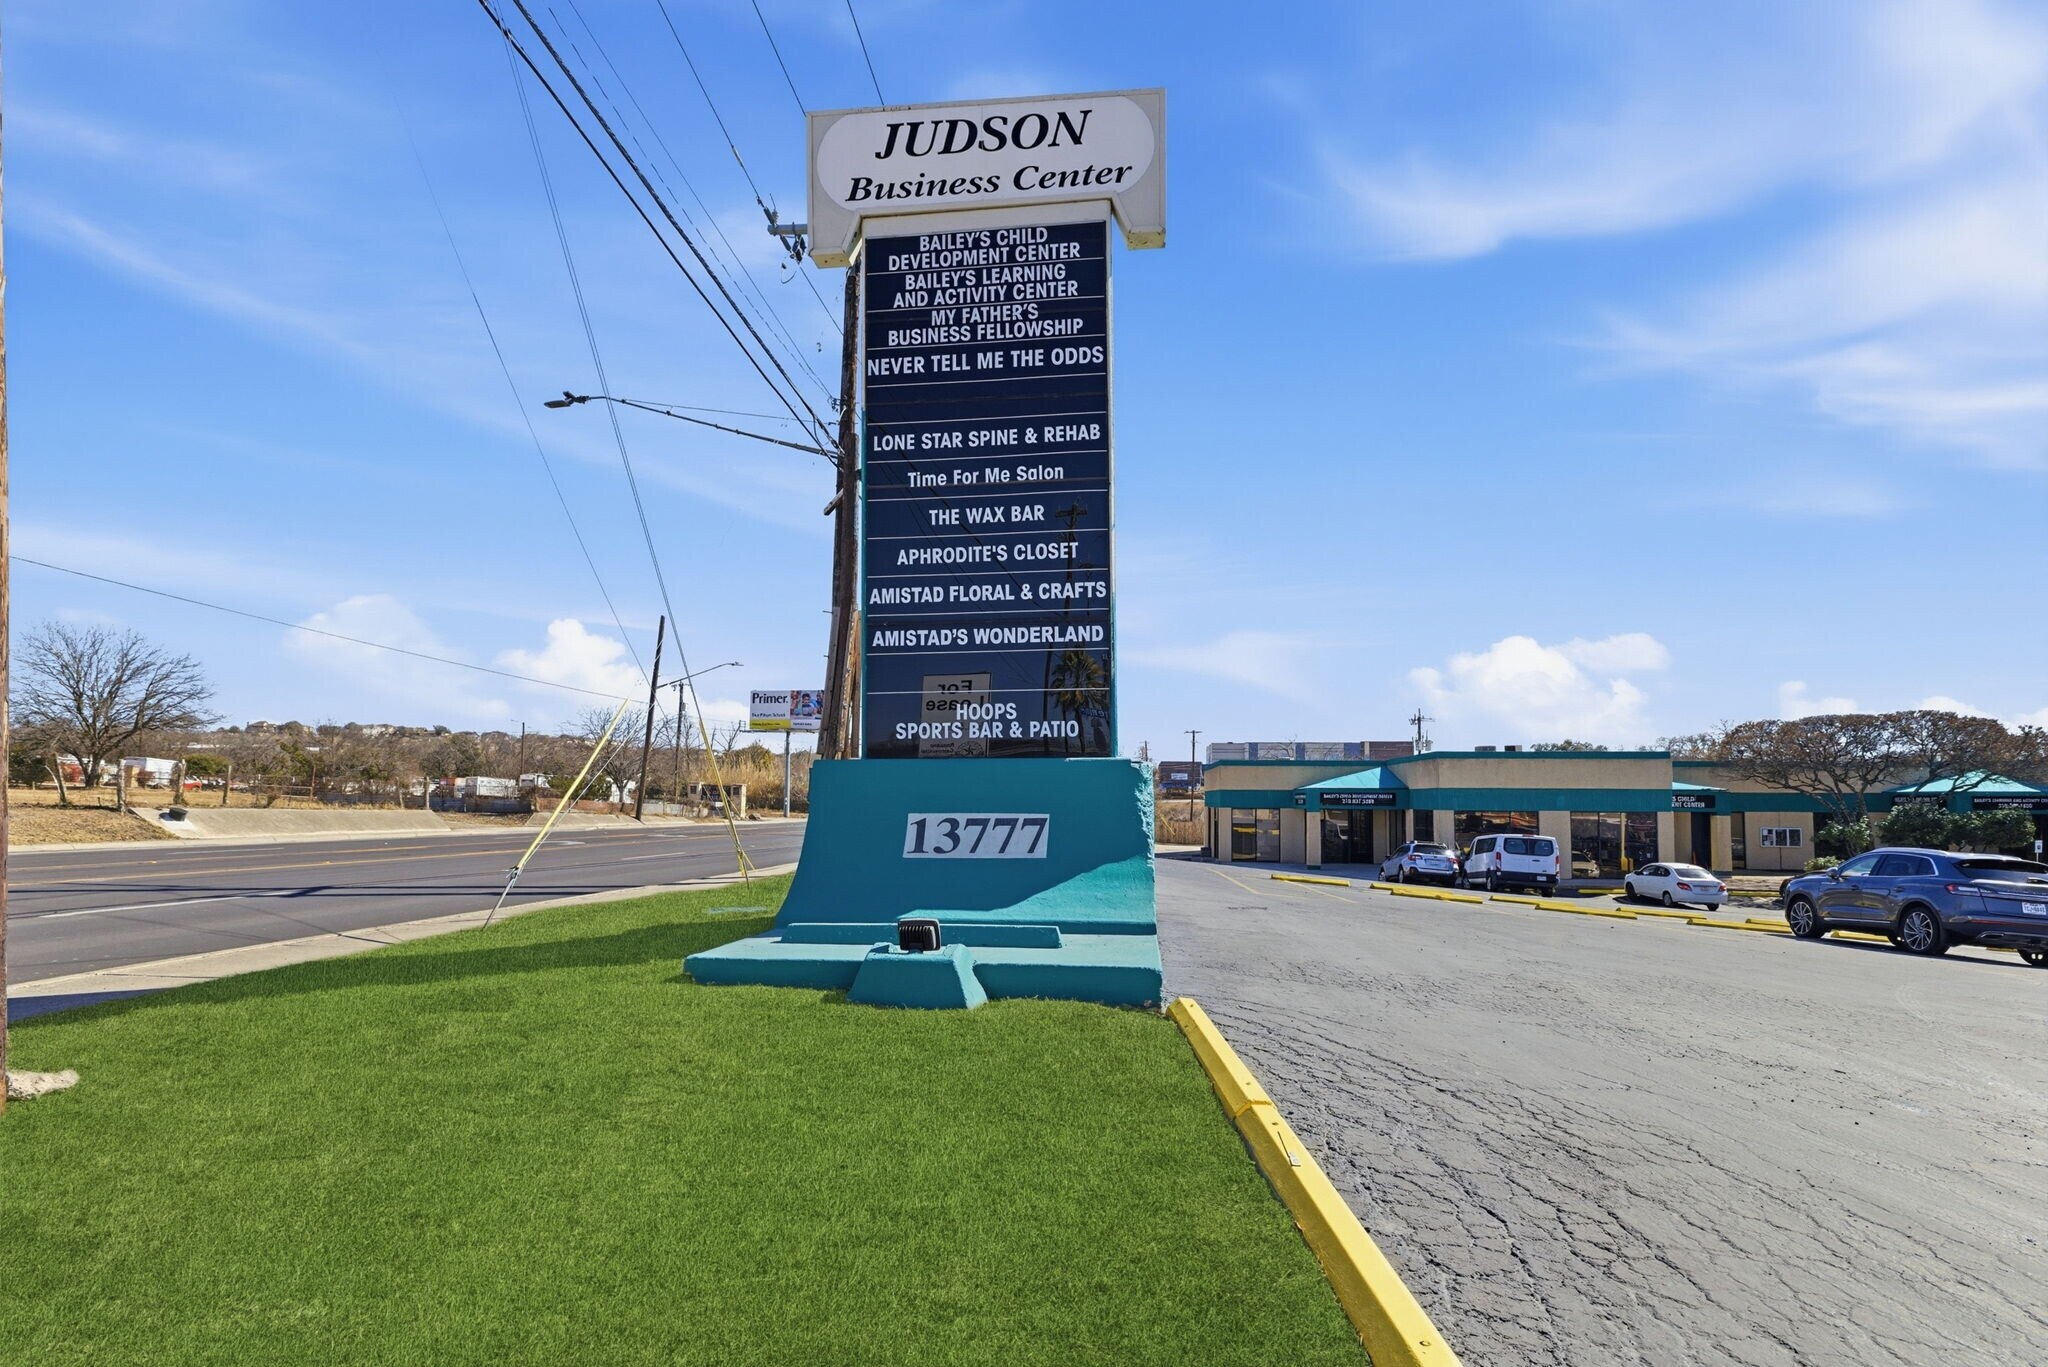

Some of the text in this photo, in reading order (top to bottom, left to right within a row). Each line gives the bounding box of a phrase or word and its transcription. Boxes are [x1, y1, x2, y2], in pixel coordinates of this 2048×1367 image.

[875, 110, 1092, 160] JUDSON
[845, 163, 1133, 202] Business Center
[919, 226, 1048, 252] BAILEY'S CHILD
[888, 242, 1081, 271] DEVELOPMENT CENTER
[905, 263, 1066, 290] BAILEY'S LEARNING
[893, 280, 1079, 309] AND ACTIVITY CENTER
[931, 302, 1039, 327] MY FATHER'S
[888, 318, 1084, 346] BUSINESS FELLOWSHIP
[867, 346, 1104, 376] NEVER TELL ME THE ODDS
[873, 424, 1100, 451] LONE STAR SPINE & REHAB
[907, 465, 1064, 487] Time For Me Salon
[929, 504, 1045, 526] THE WAX BAR
[897, 542, 1079, 565] APHRODITE'S CLOSET
[869, 581, 1107, 604] AMISTAD FLORAL & CRAFTS
[872, 625, 1104, 647] AMISTAD'S WONDERLAND
[752, 692, 789, 704] Primer.
[956, 702, 1017, 720] HOOPS
[895, 720, 1079, 740] SPORTS BAR & PATIO
[906, 817, 1048, 854] 13777
